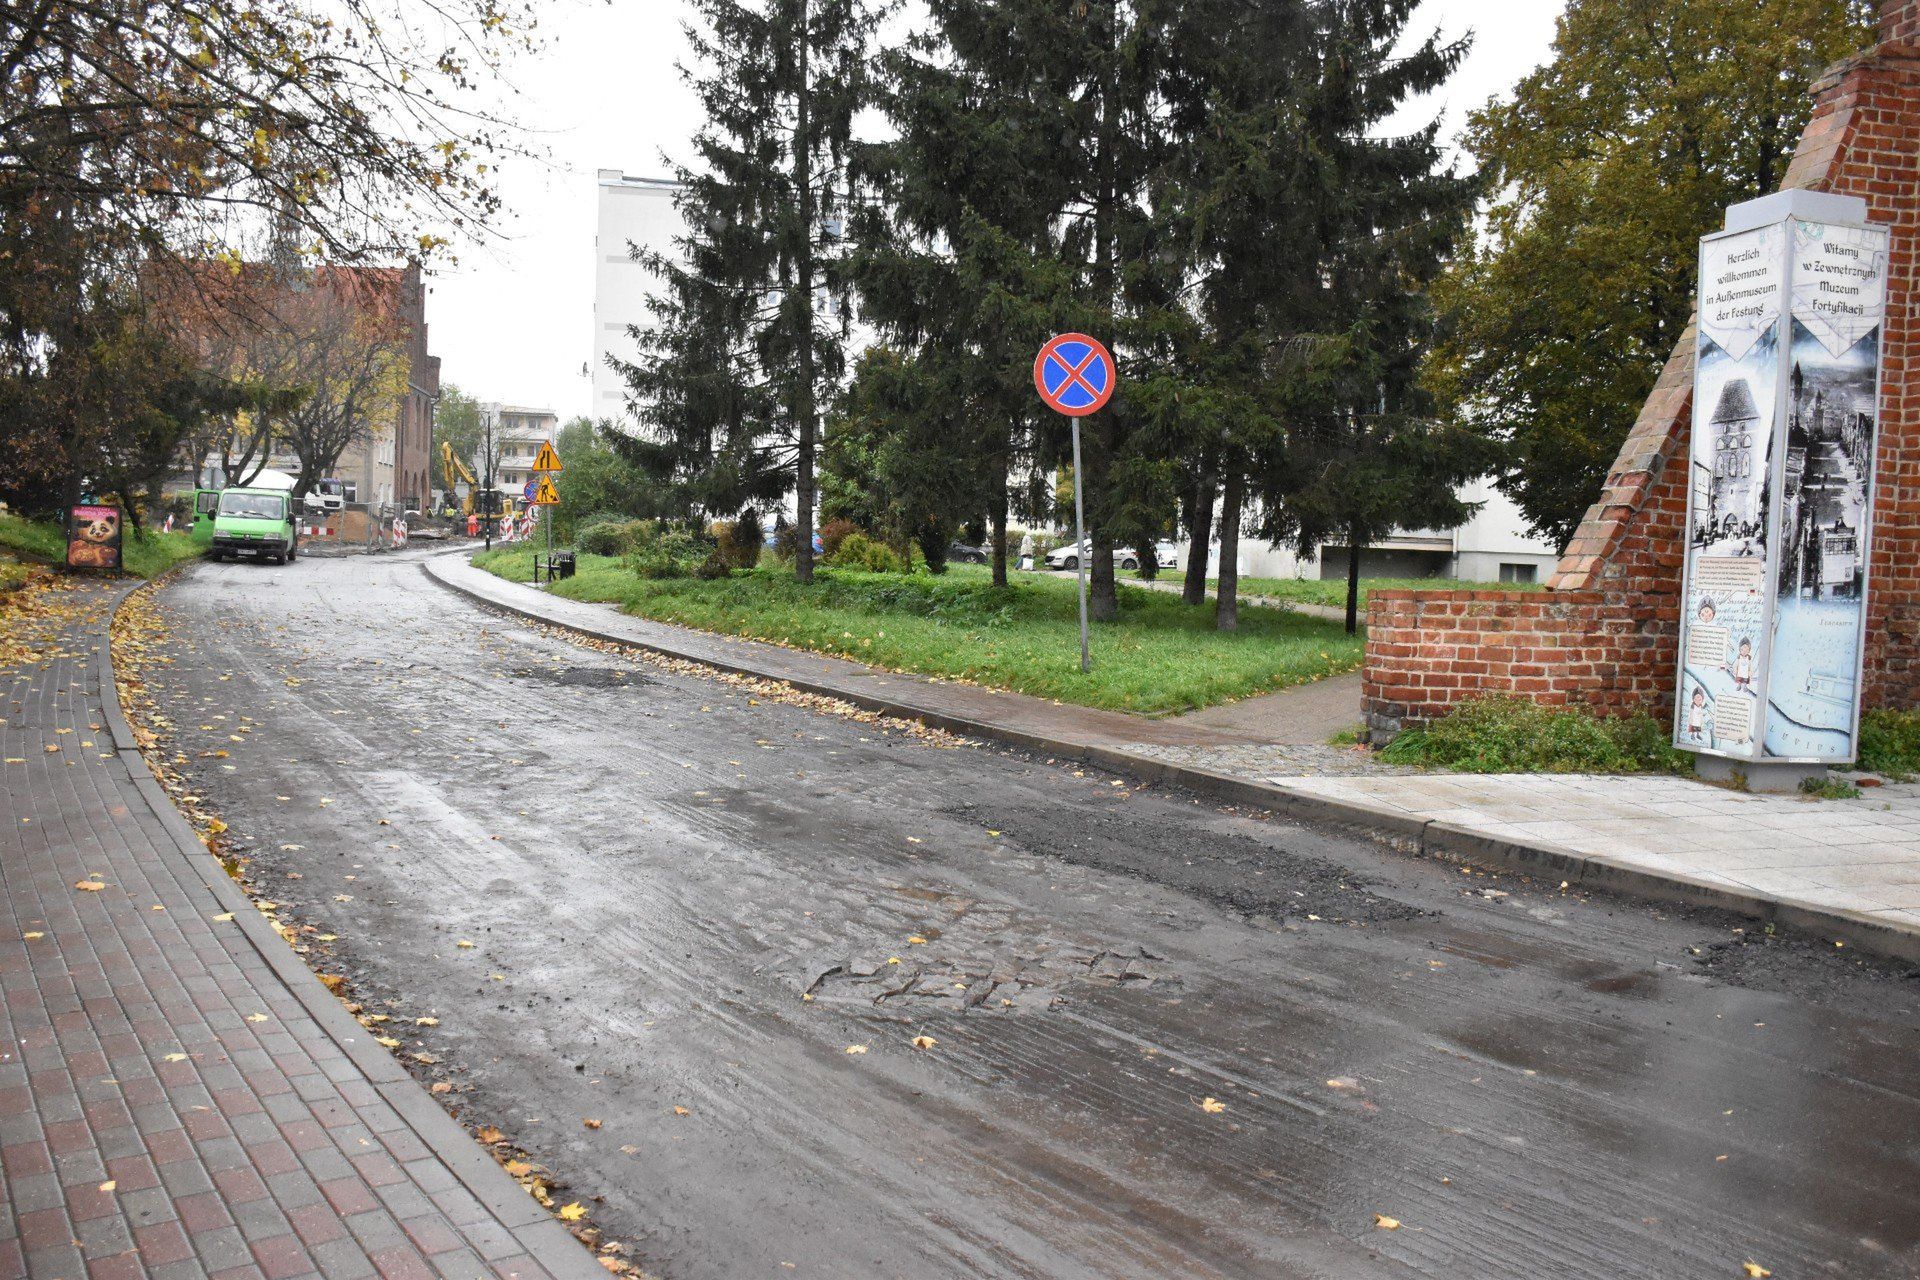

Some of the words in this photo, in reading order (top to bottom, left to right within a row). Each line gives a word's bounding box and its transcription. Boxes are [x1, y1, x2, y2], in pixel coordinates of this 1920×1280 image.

[1727, 248, 1760, 264] Herzlich
[1823, 242, 1859, 260] Witamy
[1717, 267, 1767, 284] willkommen
[1802, 262, 1812, 271] w
[1814, 260, 1876, 281] Zewnętrznym
[1706, 294, 1714, 304] in
[1715, 283, 1777, 303] Außenmuseum
[1819, 280, 1859, 295] Muzeum
[1716, 309, 1729, 321] der
[1731, 303, 1764, 319] Festung
[1812, 299, 1864, 316] Fortyfikacji
